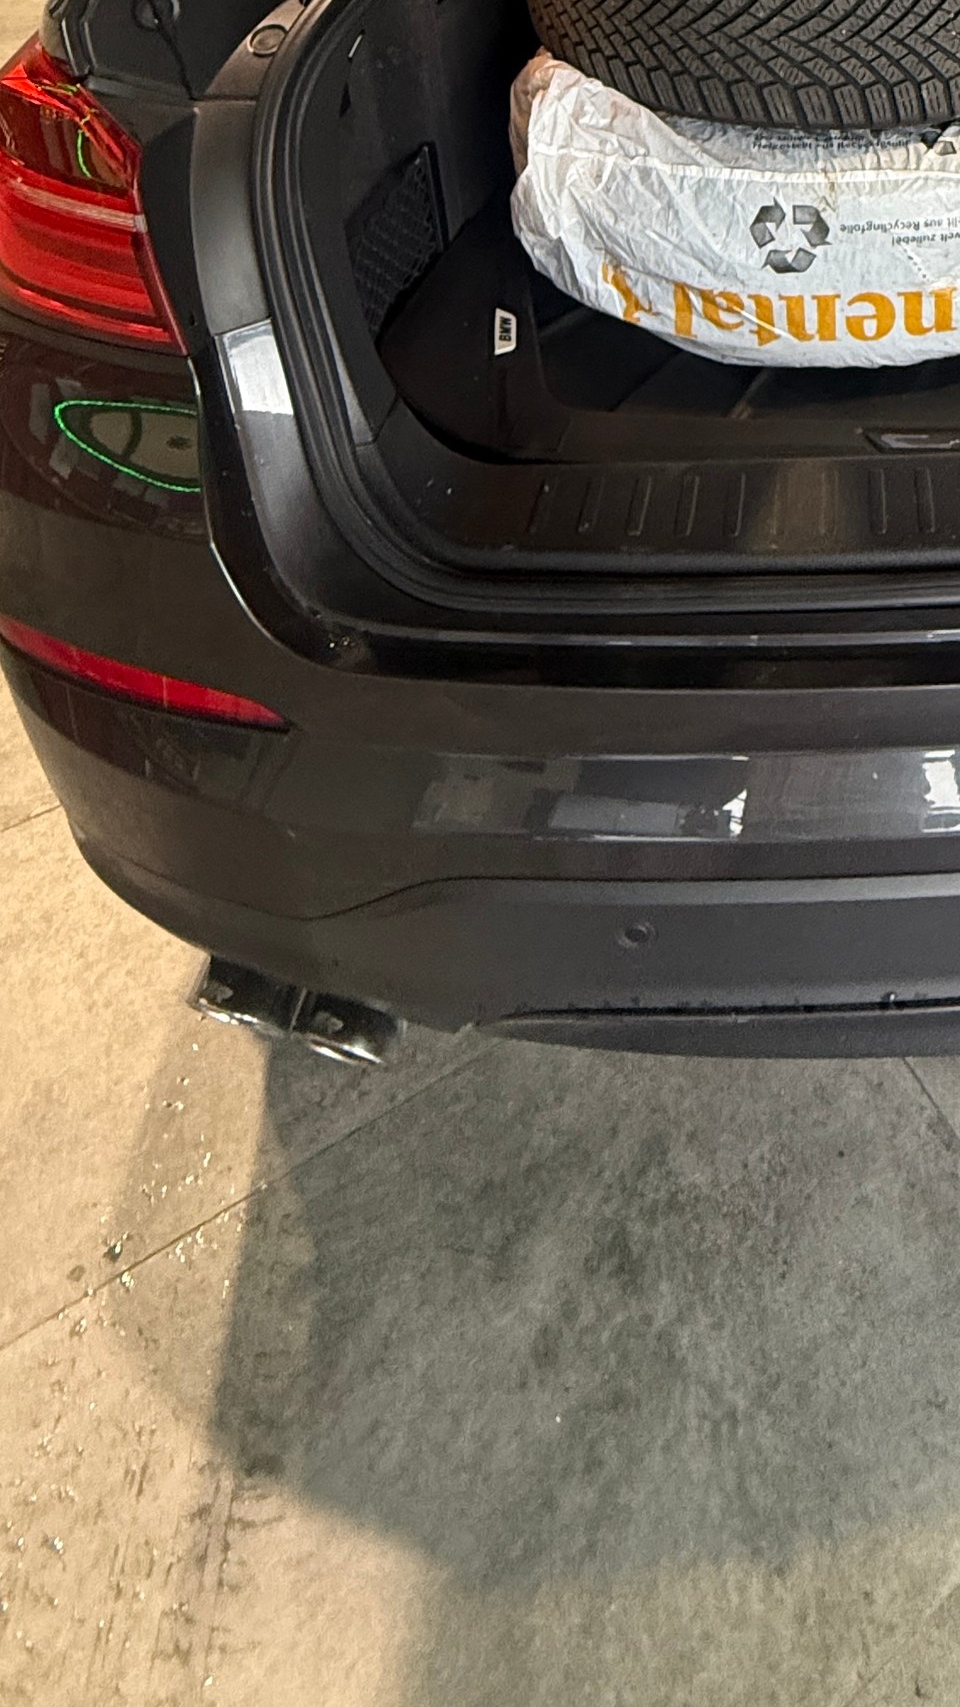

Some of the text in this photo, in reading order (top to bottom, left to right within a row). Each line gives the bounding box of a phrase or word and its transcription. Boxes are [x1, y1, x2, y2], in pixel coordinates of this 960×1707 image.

[839, 221, 921, 234] Recyclingfolie
[924, 217, 944, 230] aus
[499, 316, 512, 342] BMW
